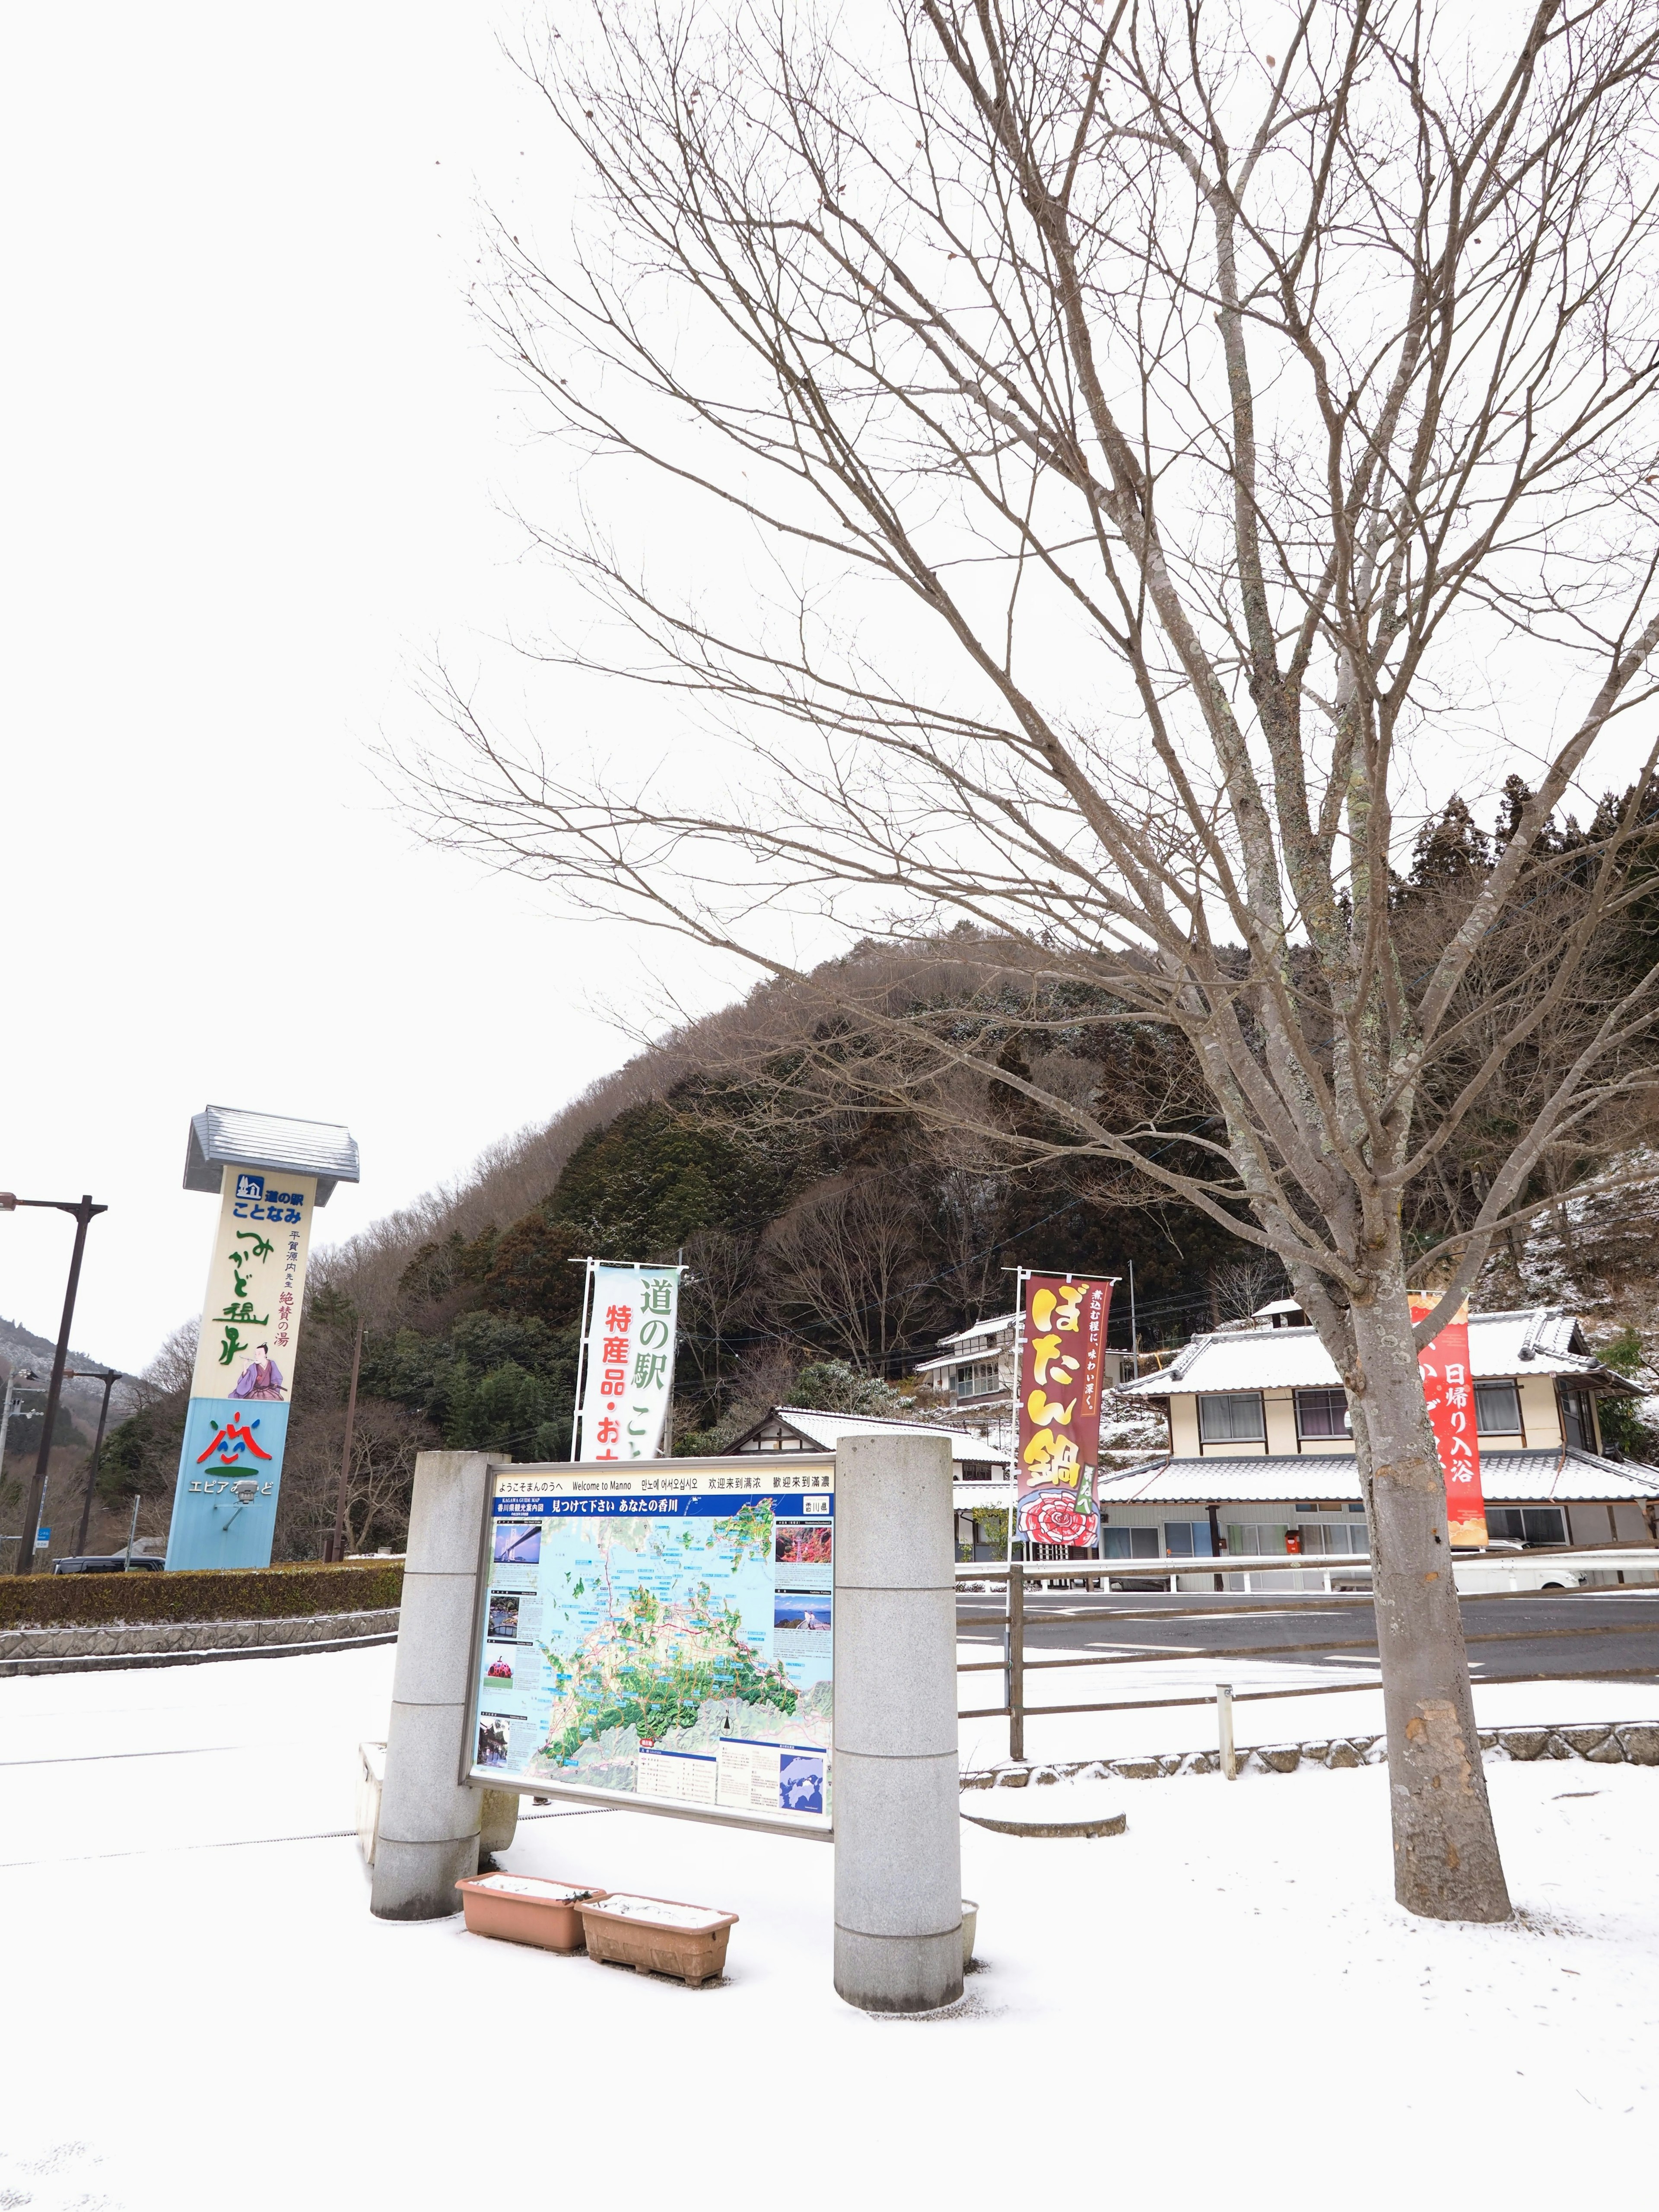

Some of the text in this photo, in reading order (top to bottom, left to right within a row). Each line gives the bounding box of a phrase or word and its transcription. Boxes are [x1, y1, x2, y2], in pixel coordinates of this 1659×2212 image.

[265, 1190, 303, 1206] 道の駅
[233, 1203, 301, 1224] ことなみ
[630, 1278, 674, 1391] 道の駅
[1023, 1283, 1090, 1488] ぼたん鍋
[1445, 1363, 1475, 1484] 日帰り入浴
[499, 1482, 563, 1493] ようこそまんのうへ
[573, 1481, 631, 1491] Welcome to Manno
[642, 1478, 698, 1491] 만노에 어서오십시오
[708, 1477, 761, 1490] 欢迎来到满浓
[773, 1476, 830, 1488] 歡迎來到滿濃
[498, 1503, 544, 1512] 香川県観光案内図
[552, 1498, 677, 1513] 見つけて下さい あなたの香川
[806, 1502, 827, 1512] 香川県
